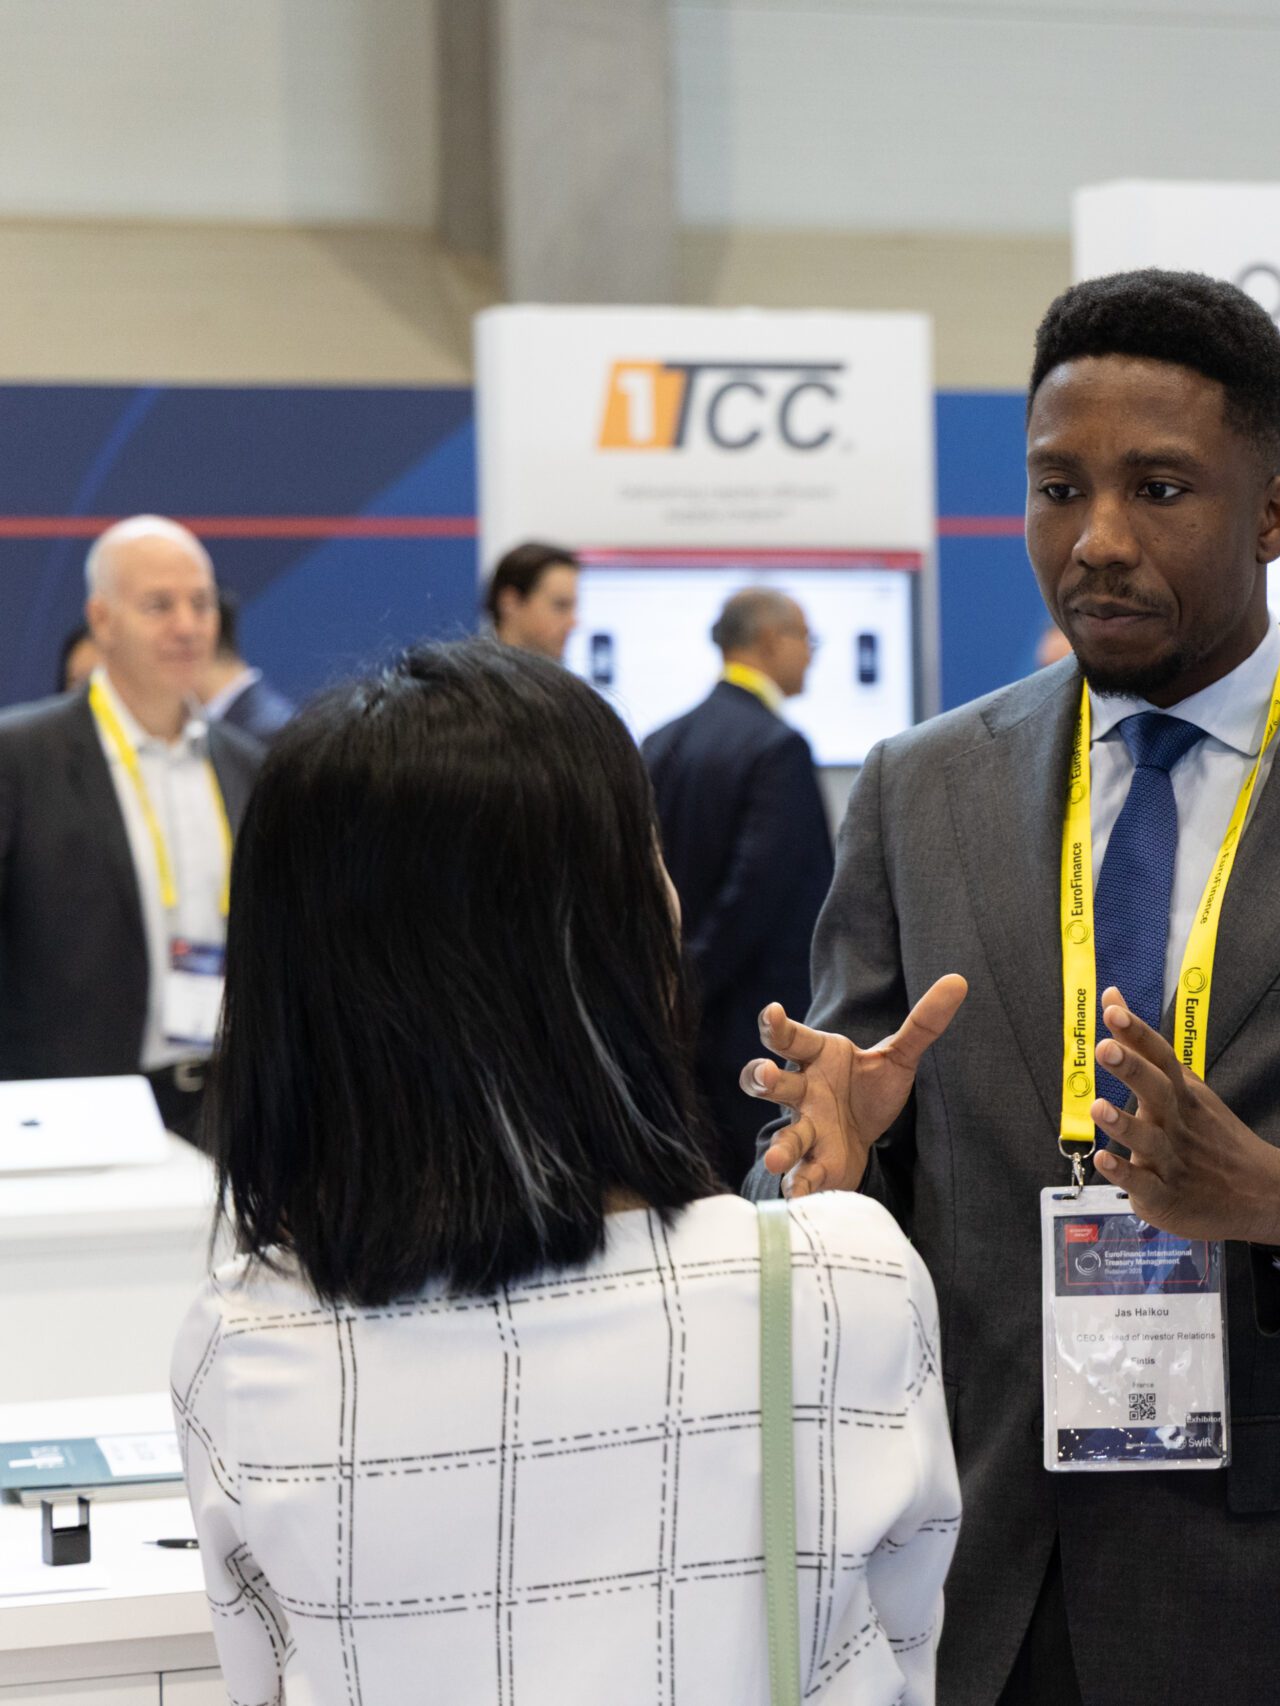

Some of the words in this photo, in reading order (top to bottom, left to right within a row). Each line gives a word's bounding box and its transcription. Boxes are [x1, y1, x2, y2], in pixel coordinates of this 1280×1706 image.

[1072, 712, 1083, 780] EuroFinan
[1070, 842, 1083, 917] EuroFinance
[1073, 988, 1087, 1067] EuroFinance
[1183, 998, 1199, 1070] EuroFinan
[1104, 1250, 1146, 1258] EuroFinance
[1147, 1249, 1192, 1257] International
[1104, 1259, 1134, 1267] Treasury
[1135, 1258, 1180, 1267] Management
[1115, 1308, 1132, 1317] Jas
[1135, 1307, 1169, 1317] Haikou
[1076, 1334, 1096, 1342] CEO
[1098, 1334, 1105, 1342] &
[1108, 1333, 1129, 1342] ead
[1131, 1332, 1141, 1341] of
[1177, 1331, 1216, 1340] Relations
[1185, 1415, 1221, 1423] Exhibitor
[1188, 1437, 1212, 1447] Swift
